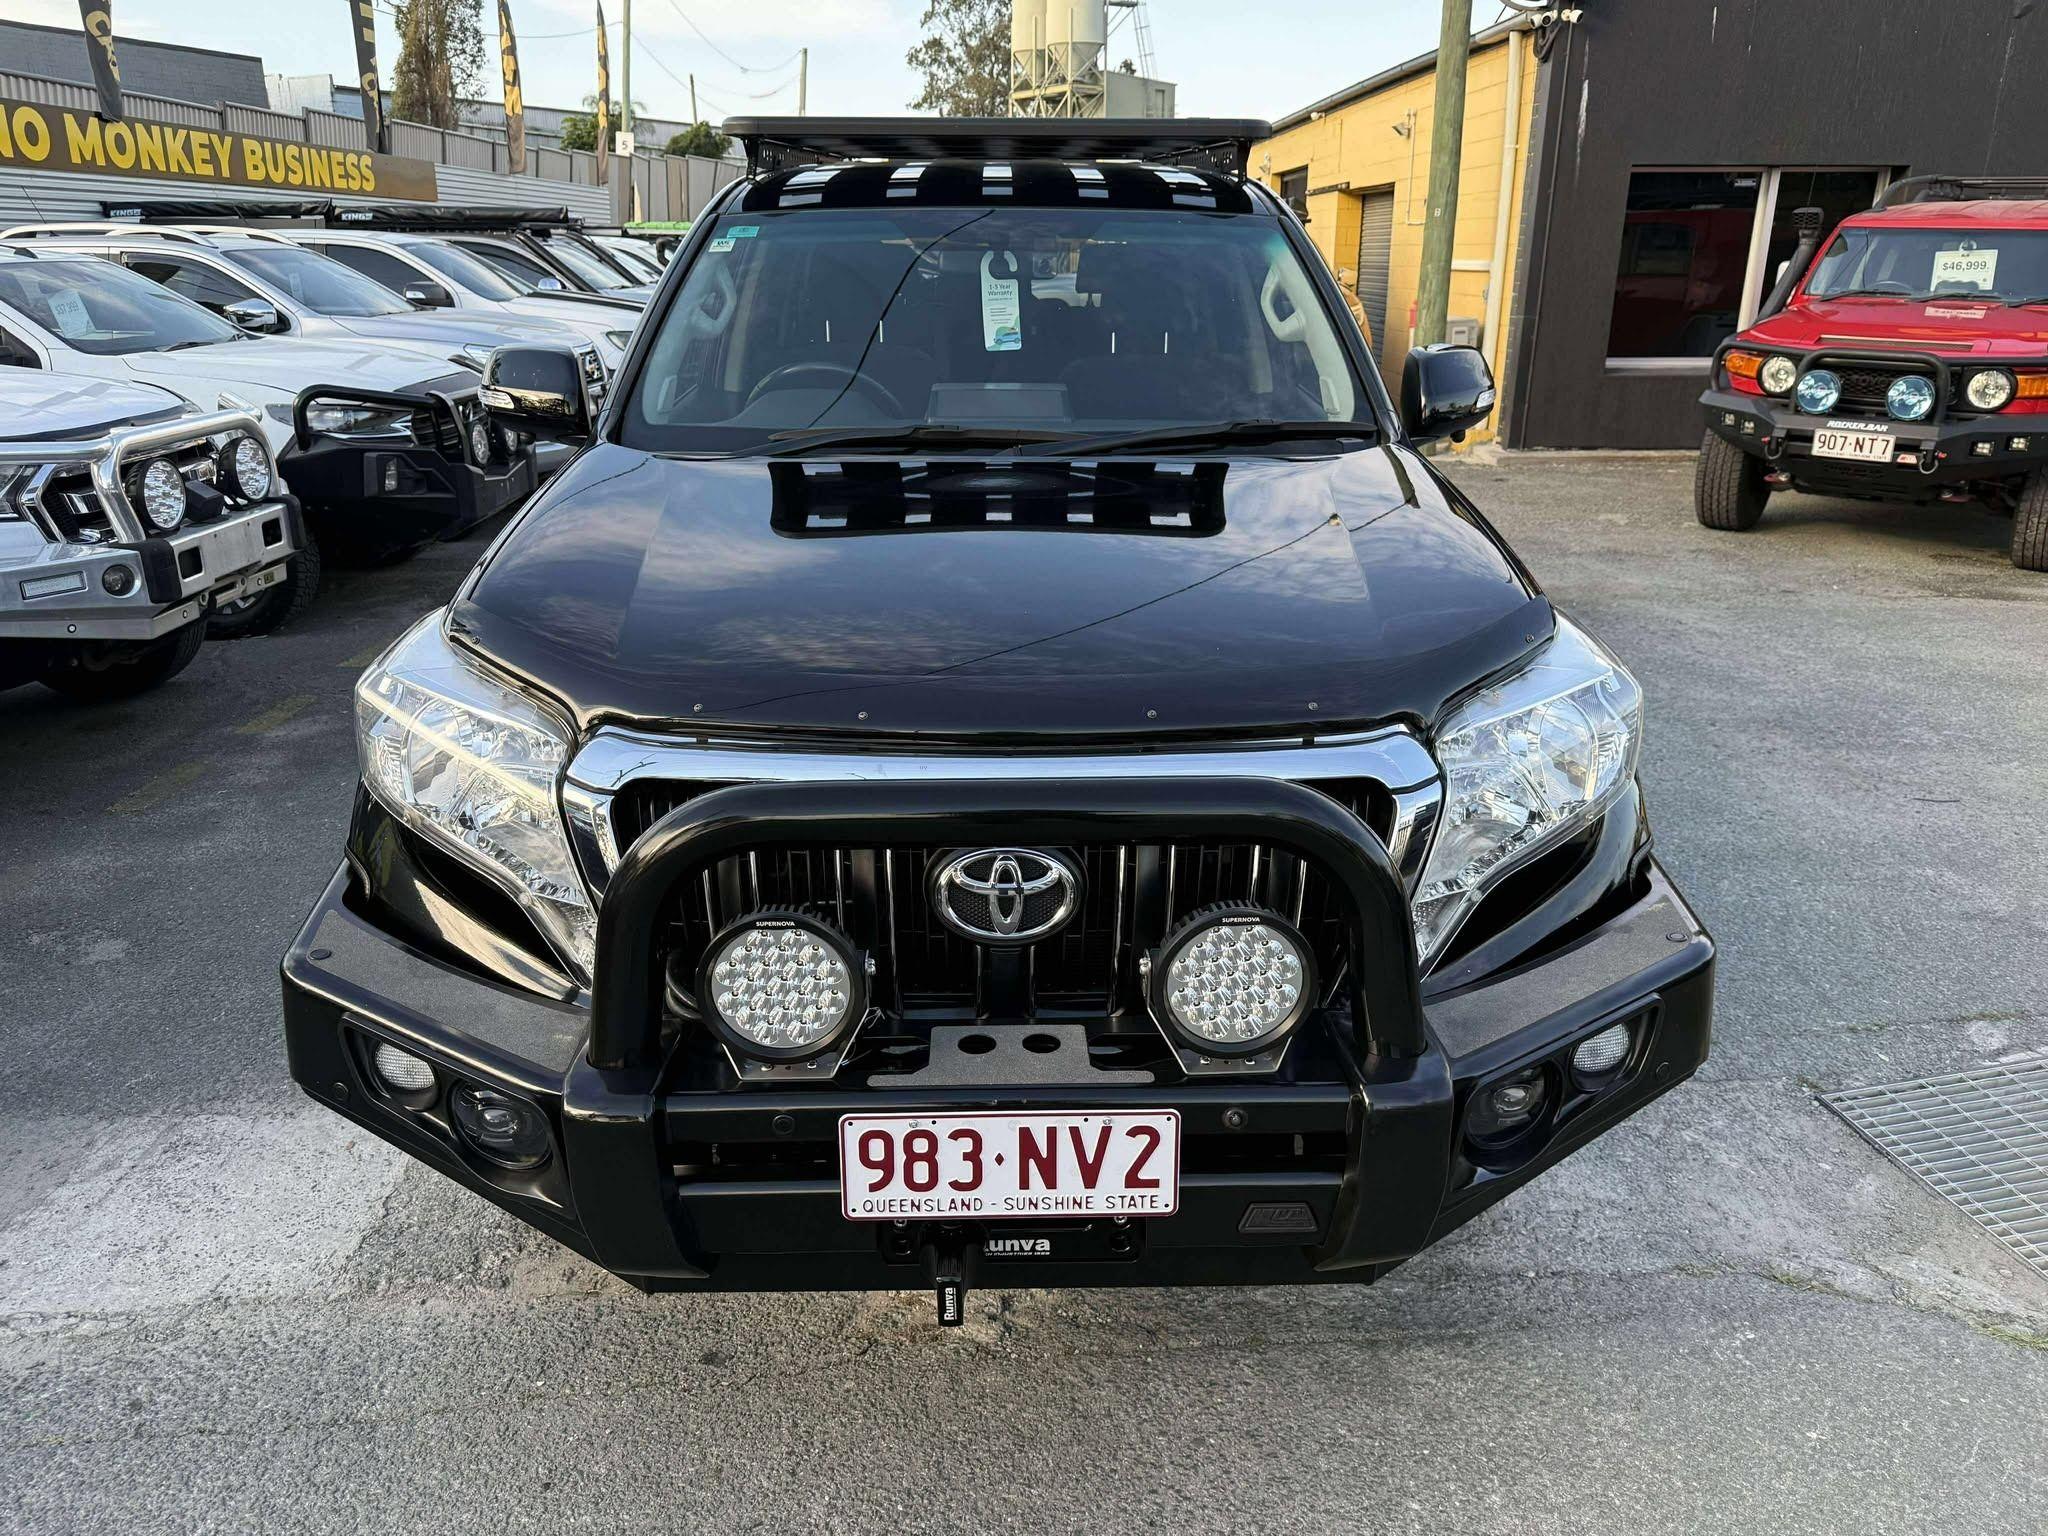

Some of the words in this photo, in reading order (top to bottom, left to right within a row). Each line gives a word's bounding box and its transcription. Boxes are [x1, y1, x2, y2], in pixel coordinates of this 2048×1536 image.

[622, 140, 629, 150] 5
[63, 112, 233, 178] MONKEY
[242, 137, 376, 192] BUSINESS
[110, 208, 142, 217] KINGS
[341, 212, 373, 221] KINGS
[987, 289, 1013, 297] Warranty
[862, 1197, 984, 1213] QUEENSLAND
[1003, 1195, 1095, 1211] SUNSHINE
[1105, 1194, 1159, 1210] STATE
[943, 1287, 955, 1321] Runva
